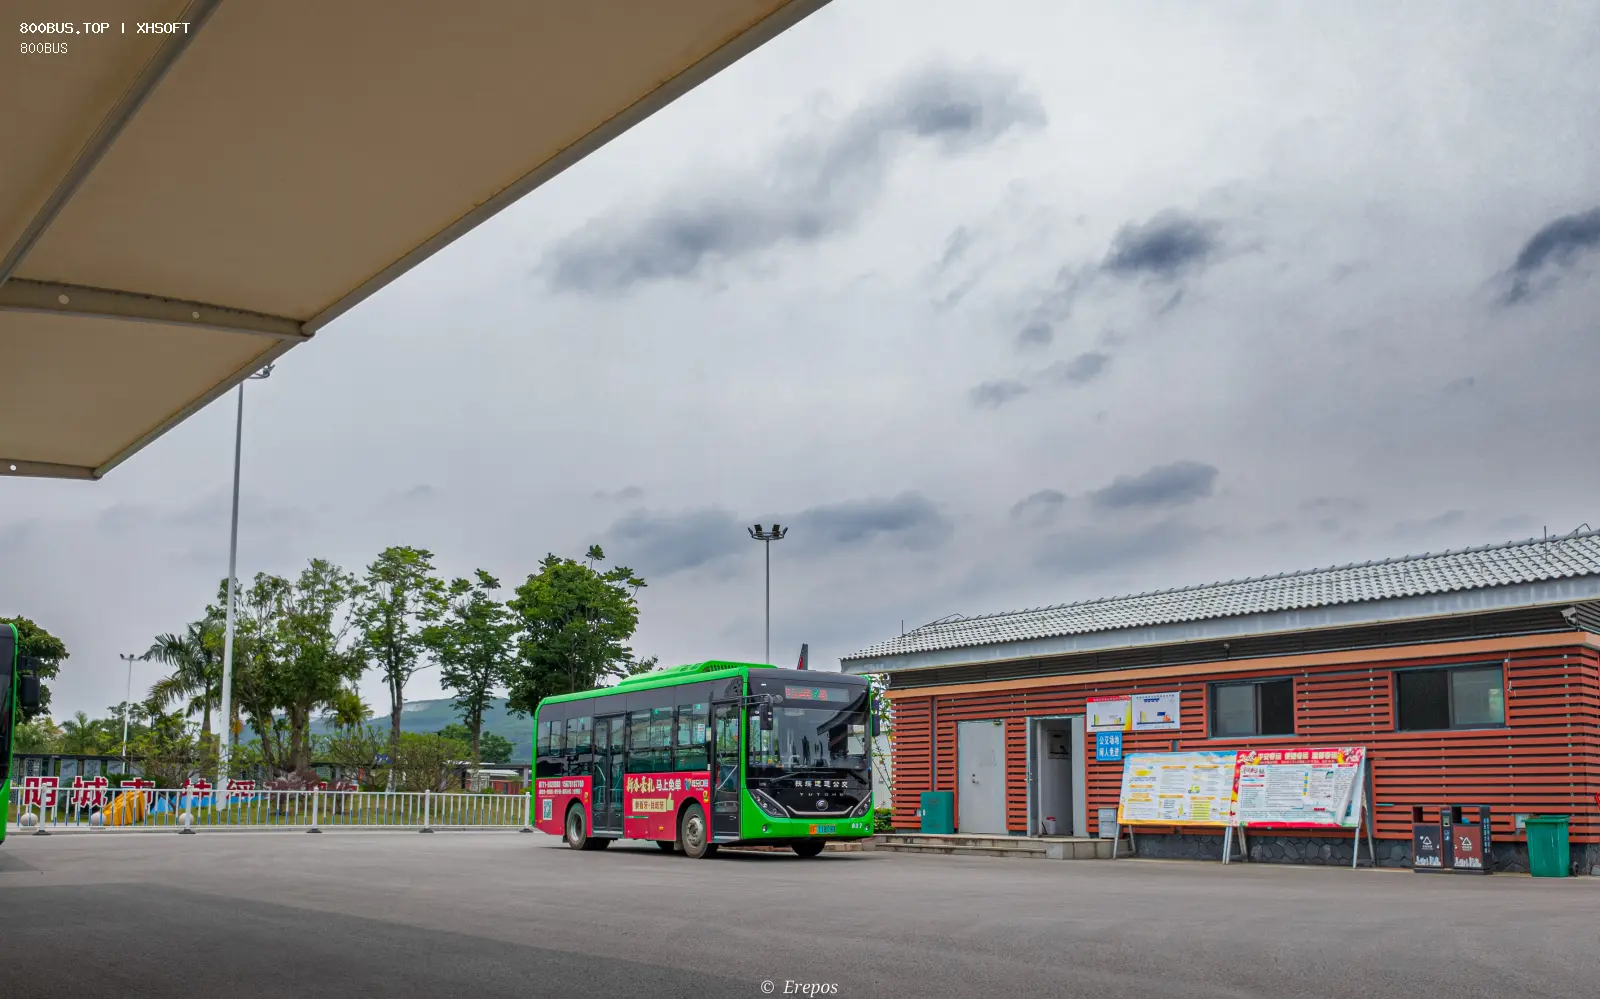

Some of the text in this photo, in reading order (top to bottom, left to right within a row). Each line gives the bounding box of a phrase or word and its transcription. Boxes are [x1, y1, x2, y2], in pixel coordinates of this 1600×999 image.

[1099, 735, 1120, 745] 公交场地
[656, 778, 682, 792] 马上免单
